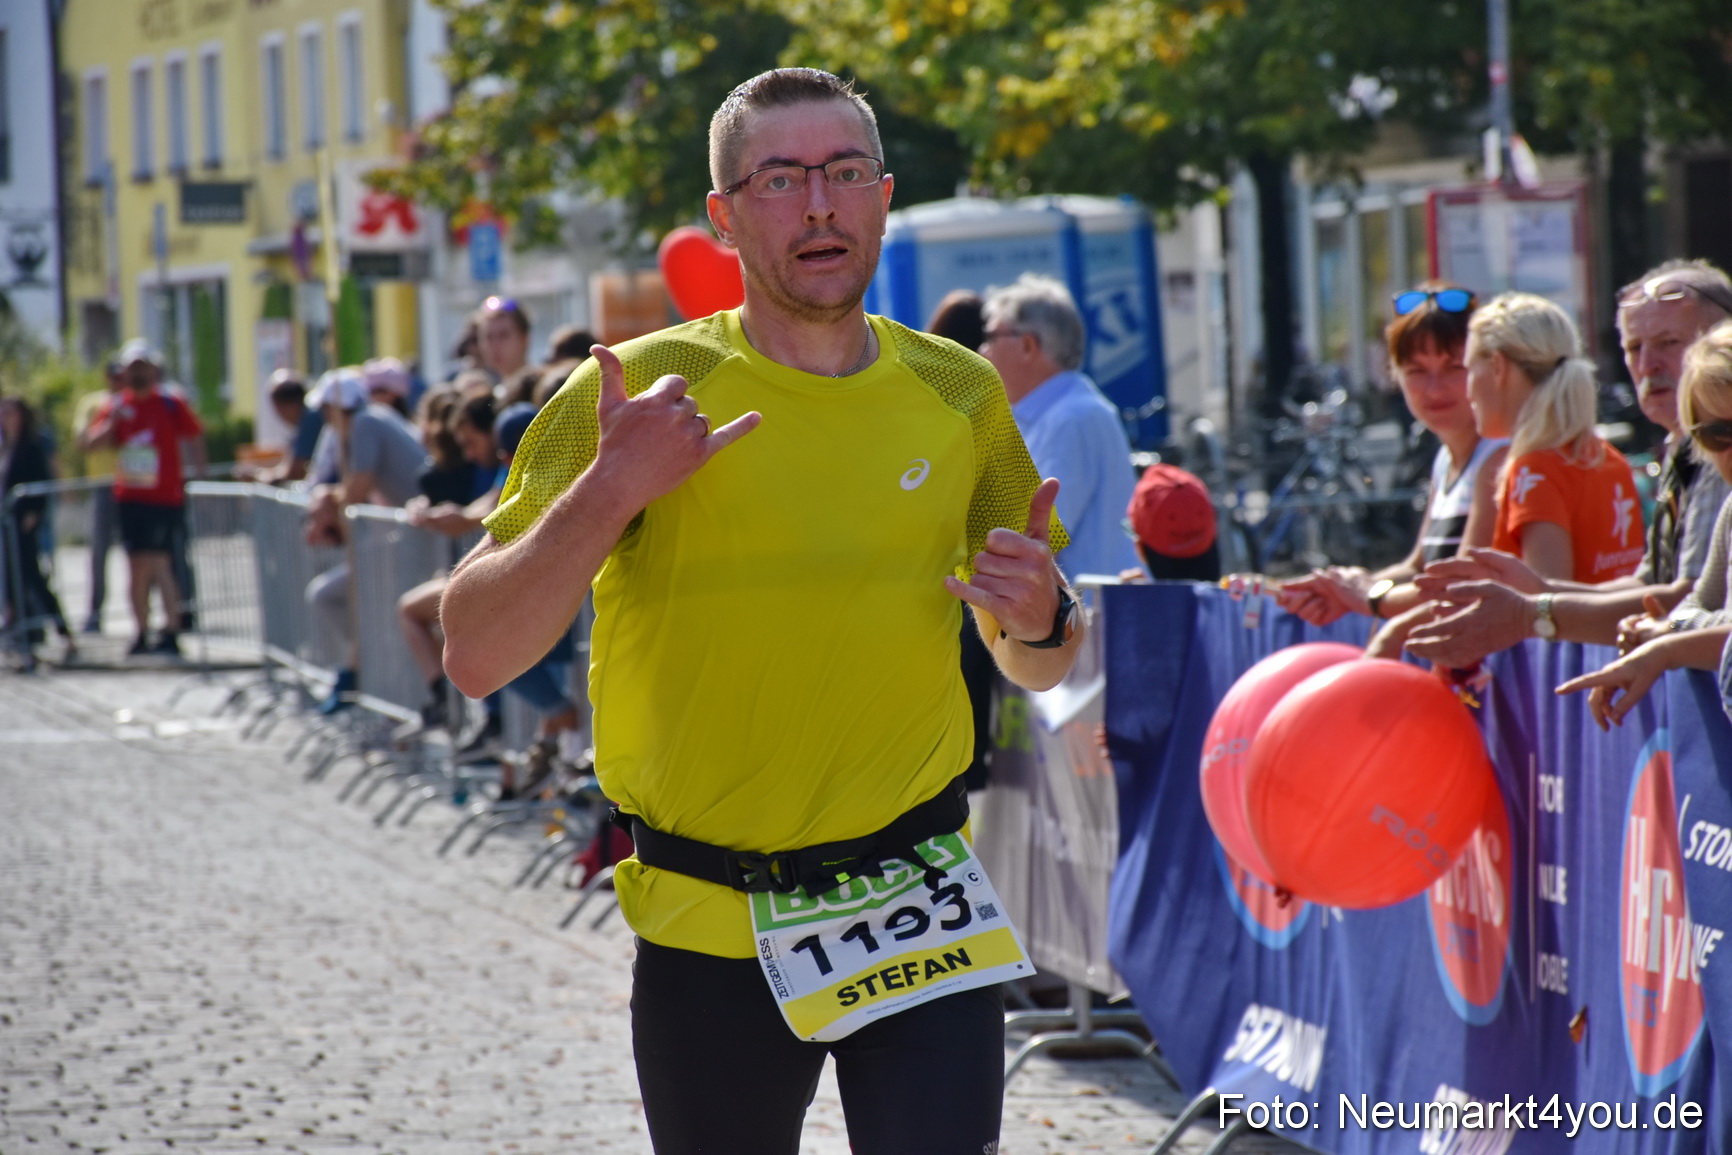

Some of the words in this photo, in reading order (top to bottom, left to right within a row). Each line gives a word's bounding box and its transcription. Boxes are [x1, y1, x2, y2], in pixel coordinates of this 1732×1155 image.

[967, 872, 979, 882] C
[791, 882, 972, 976] 1193
[836, 947, 973, 1007] STEFAN
